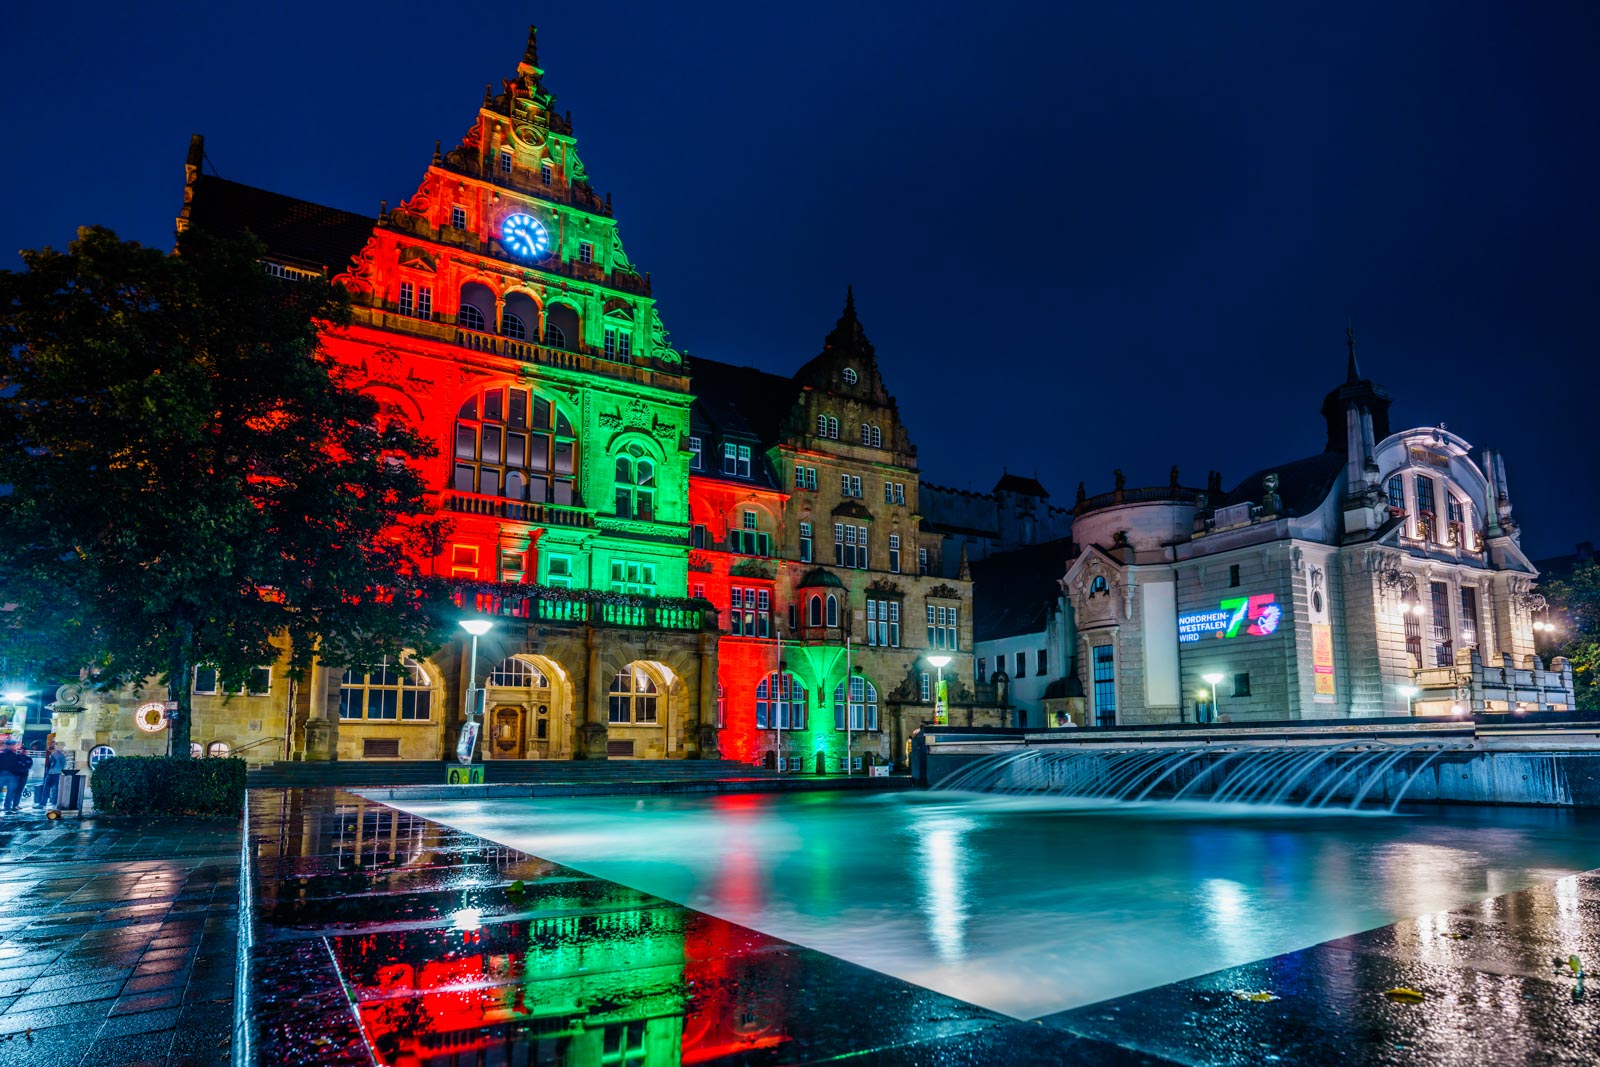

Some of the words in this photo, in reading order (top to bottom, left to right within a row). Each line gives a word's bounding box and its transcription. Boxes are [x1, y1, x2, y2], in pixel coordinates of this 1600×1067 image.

[1179, 611, 1229, 625] NORDRHEIN-
[1179, 621, 1227, 633] WESTFALEN
[1179, 633, 1199, 642] WIRD
